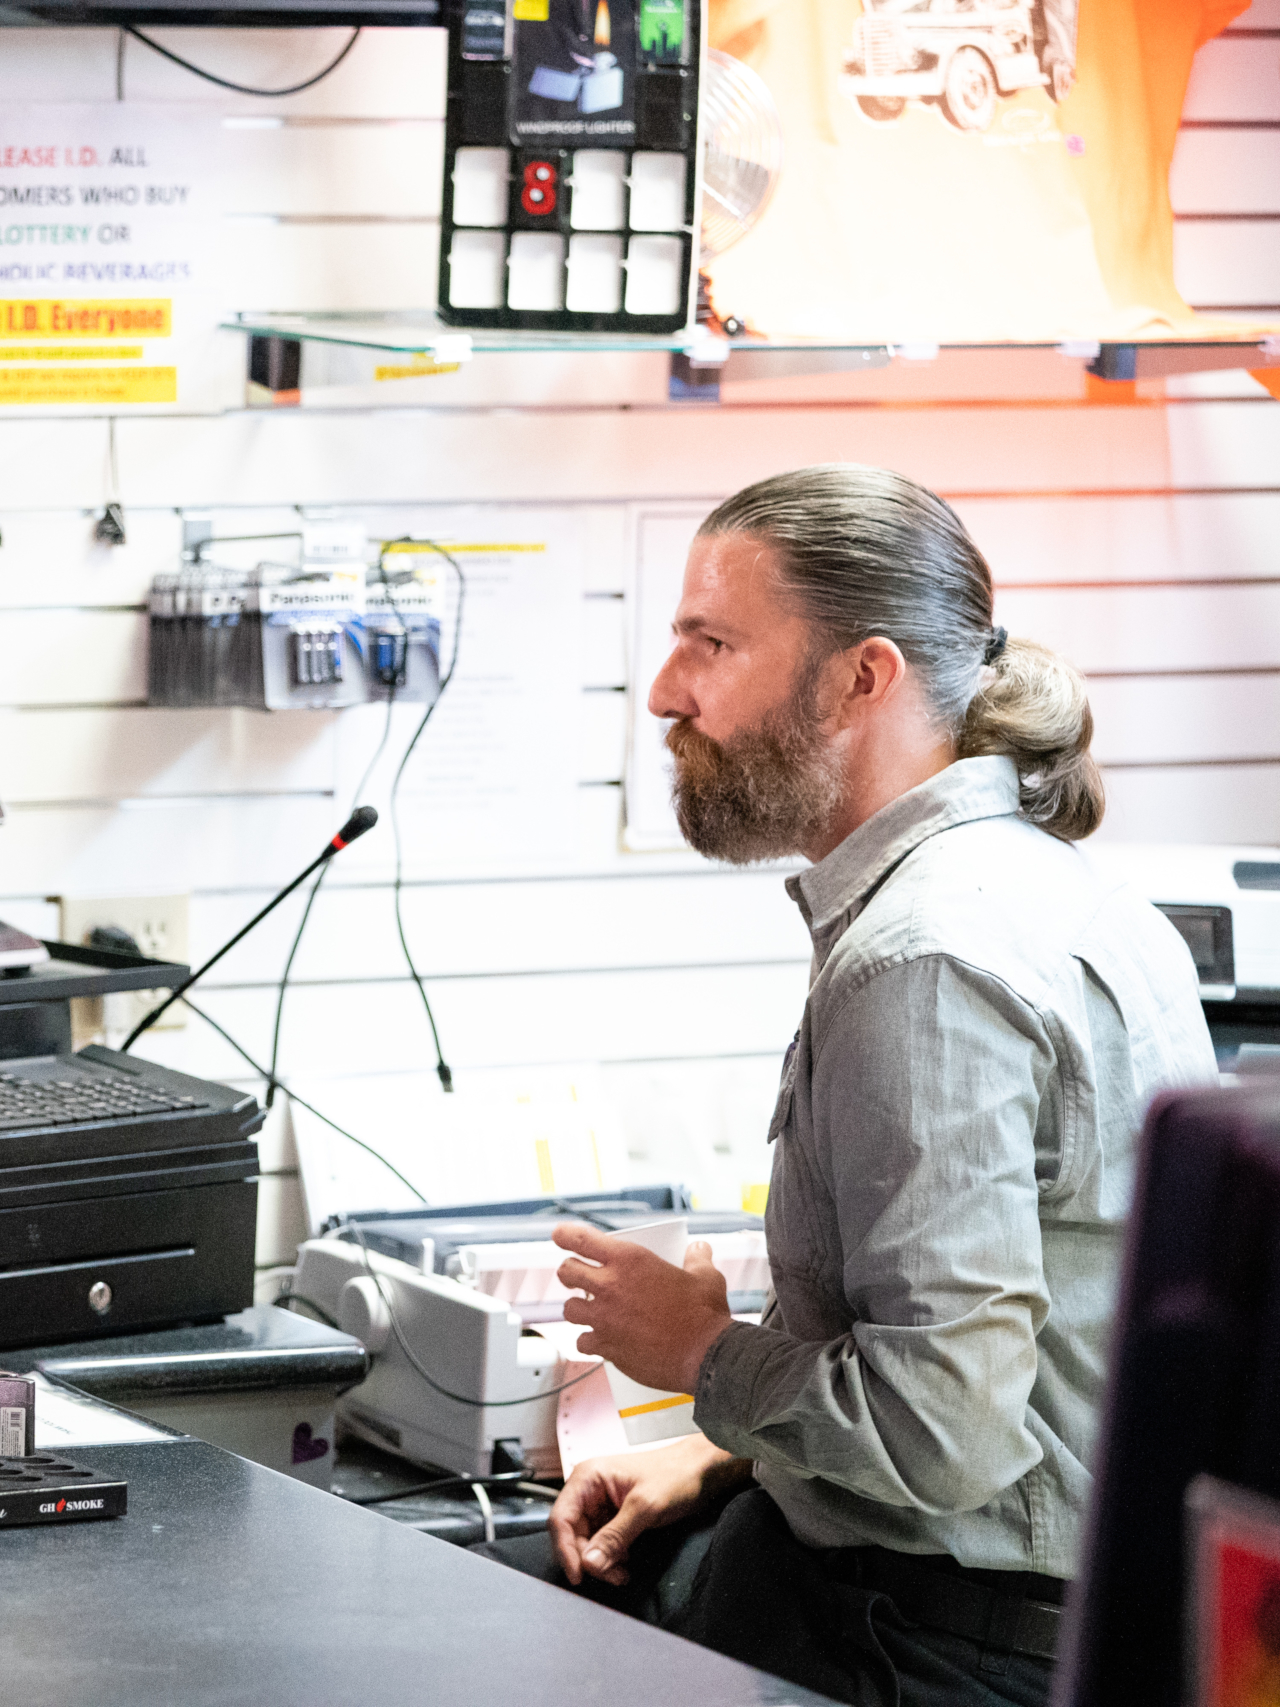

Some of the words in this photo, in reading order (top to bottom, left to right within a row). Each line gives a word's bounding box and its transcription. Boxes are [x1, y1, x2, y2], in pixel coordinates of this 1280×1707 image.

[110, 146, 147, 168] ALL
[79, 185, 141, 207] WHO
[145, 185, 191, 206] BUY
[521, 160, 557, 215] 8
[97, 224, 132, 245] OR
[62, 261, 192, 283] BEVERAGES
[52, 303, 164, 333] Everyone
[39, 1502, 56, 1513] GH
[66, 1499, 104, 1512] SMOKE
